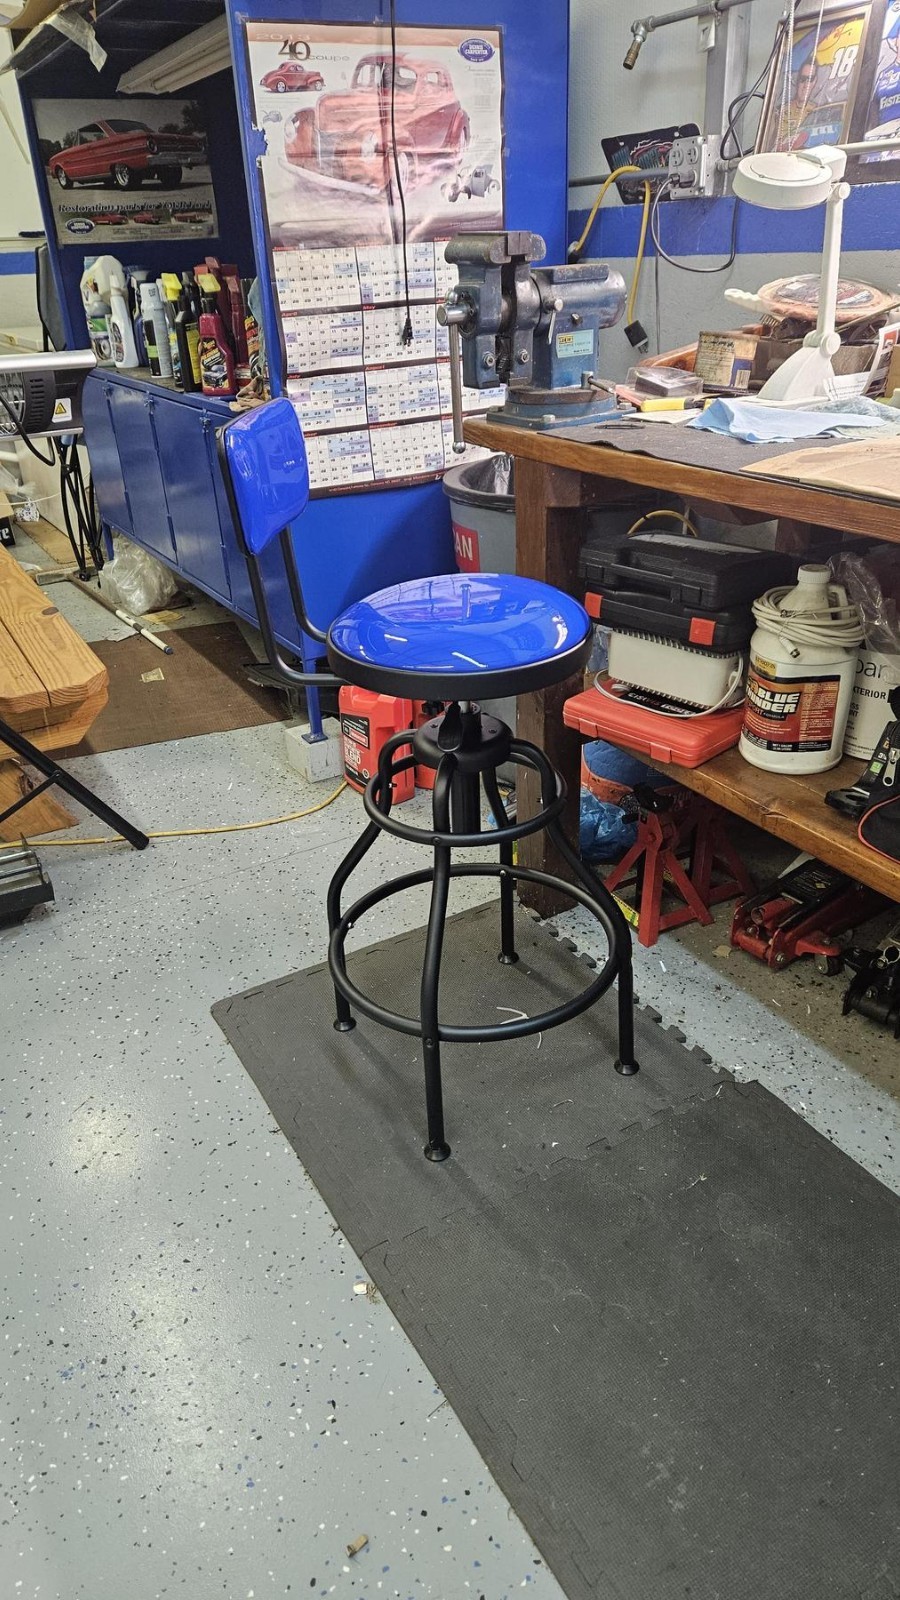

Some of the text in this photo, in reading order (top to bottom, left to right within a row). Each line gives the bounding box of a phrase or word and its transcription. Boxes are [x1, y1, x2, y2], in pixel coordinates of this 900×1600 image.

[829, 45, 859, 80] 18
[58, 202, 114, 213] Restoration
[117, 202, 142, 213] parts
[758, 687, 800, 703] BLUE
